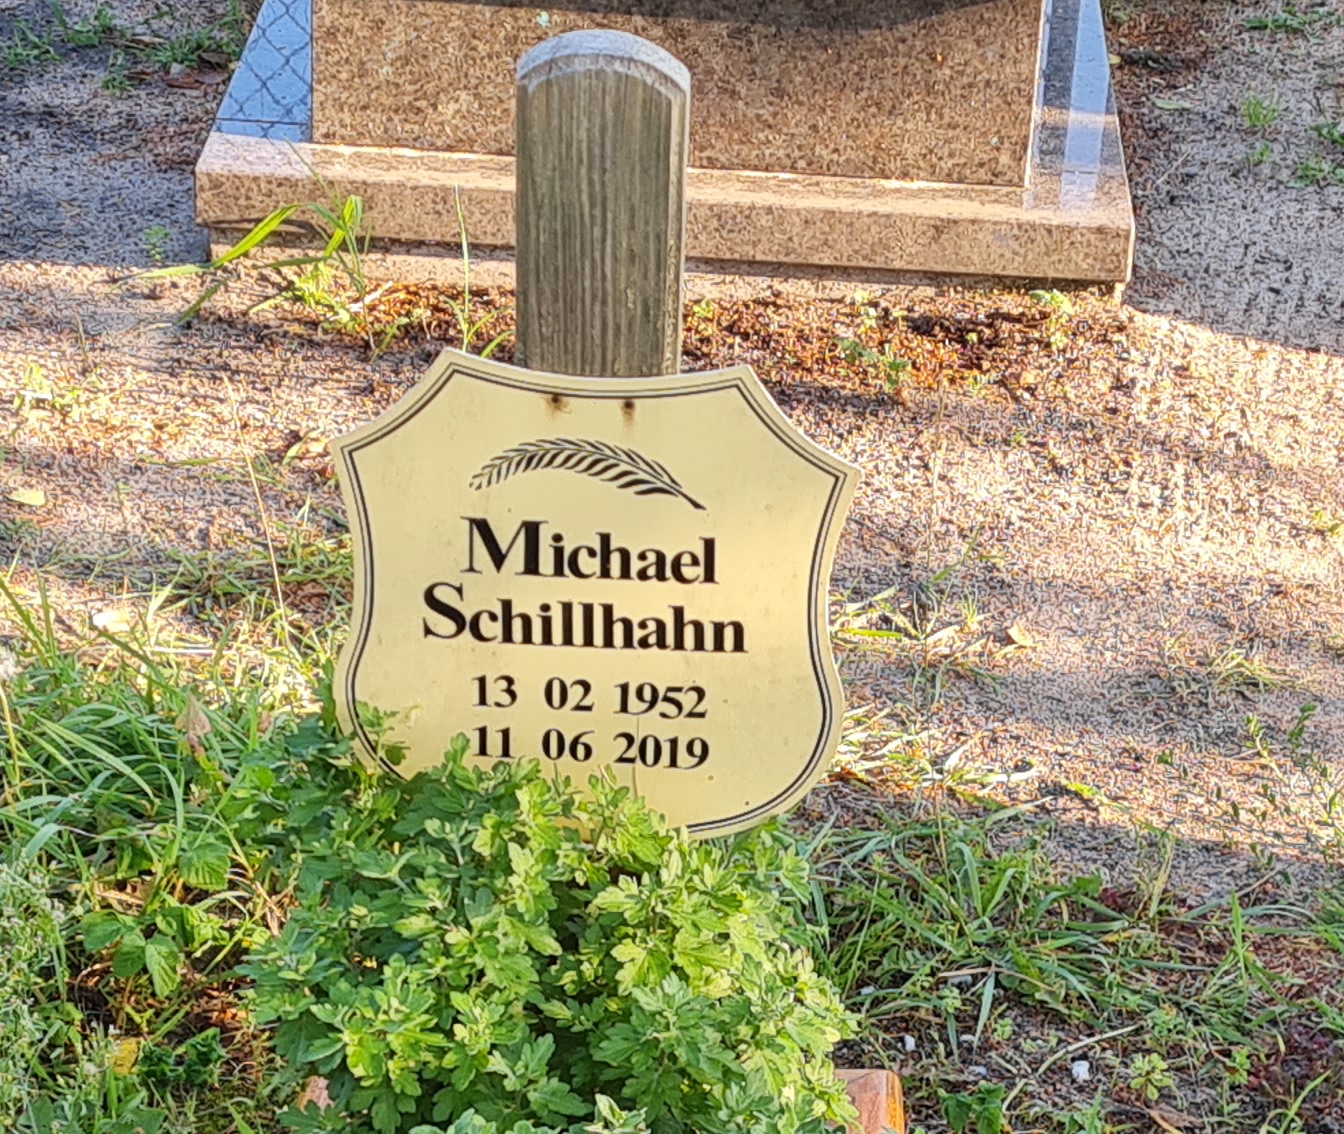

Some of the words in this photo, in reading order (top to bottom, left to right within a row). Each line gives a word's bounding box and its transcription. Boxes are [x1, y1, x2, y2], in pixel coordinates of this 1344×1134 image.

[461, 516, 718, 584] Michael
[423, 582, 747, 653] Schillhahn
[472, 675, 518, 708] 13
[544, 677, 594, 712] 02
[613, 682, 708, 719] 1952
[472, 725, 514, 759] 11
[541, 728, 593, 762] 06
[613, 732, 710, 769] 2019
